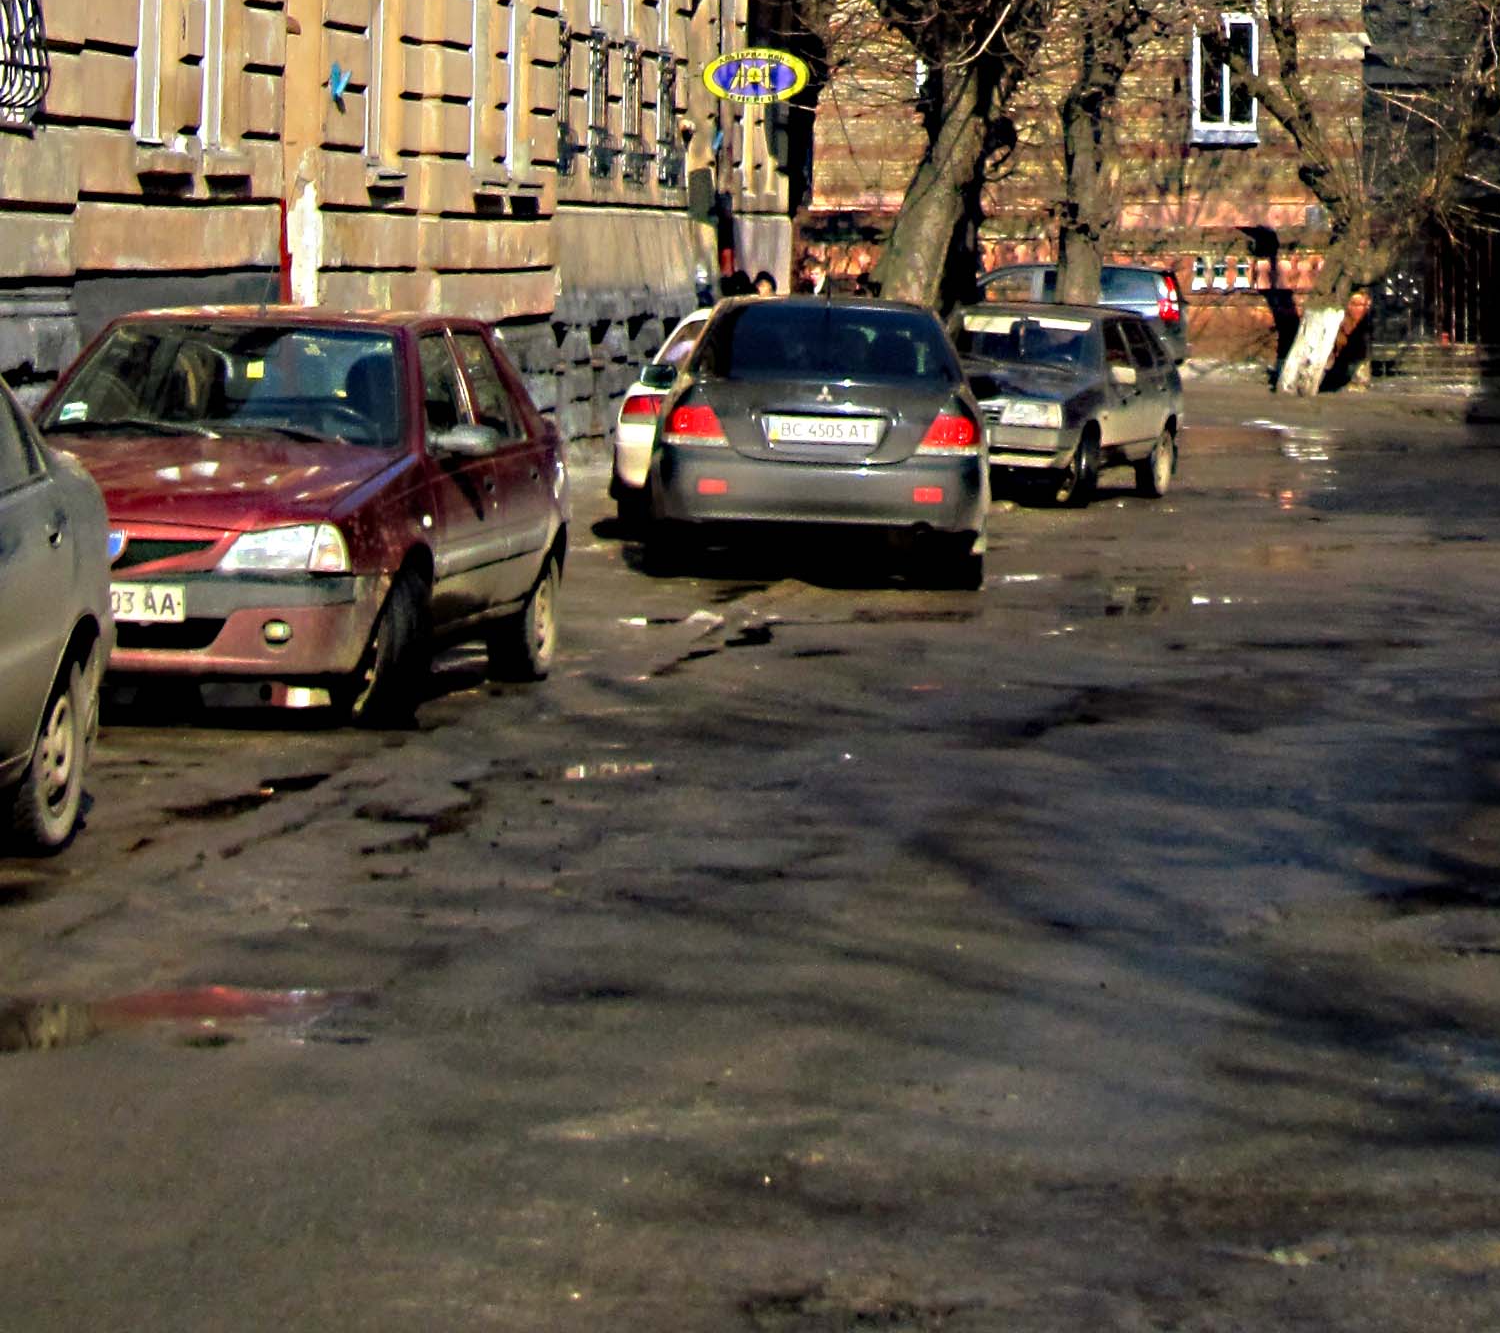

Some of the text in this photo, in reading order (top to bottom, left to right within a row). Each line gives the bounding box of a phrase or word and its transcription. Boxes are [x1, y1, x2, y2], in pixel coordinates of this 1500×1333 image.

[781, 422, 870, 439] BC 4505 AT
[144, 590, 175, 615] AA
